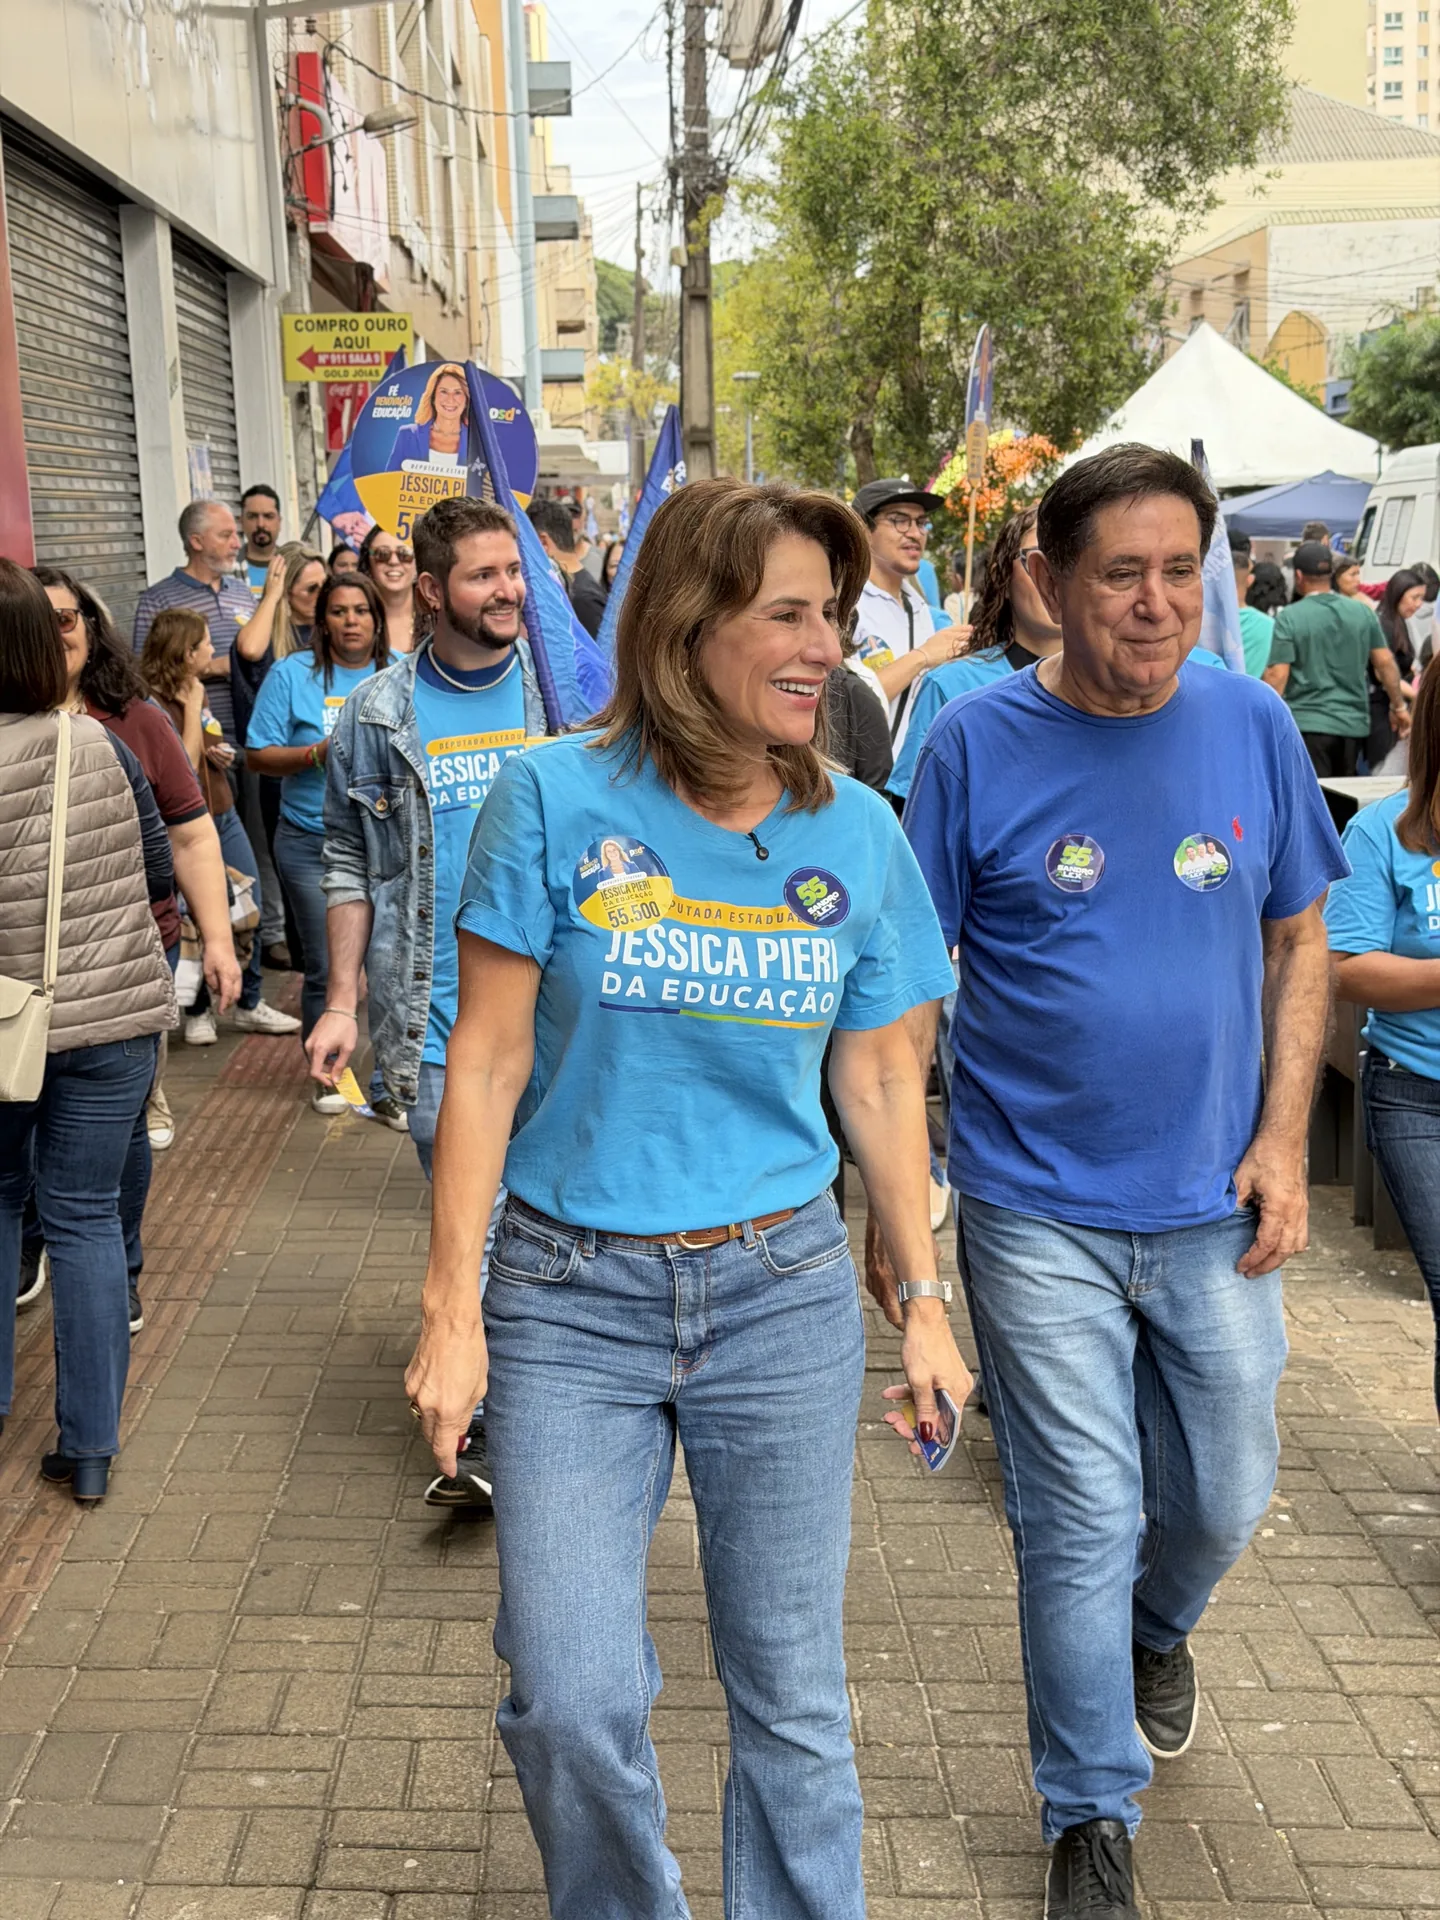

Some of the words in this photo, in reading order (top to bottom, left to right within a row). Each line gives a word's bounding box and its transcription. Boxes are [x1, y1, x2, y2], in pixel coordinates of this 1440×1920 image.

[294, 319, 359, 332] COMPRO
[364, 318, 408, 331] OURO
[333, 336, 371, 349] AQUI
[348, 353, 373, 364] SALA
[324, 369, 349, 378] GOLD
[388, 383, 400, 396] FÉ
[372, 406, 412, 420] EDUCAÇÃO
[399, 494, 414, 503] DA
[439, 738, 485, 750] DEPUTADA
[428, 752, 500, 789] ÉSSICA
[1060, 845, 1092, 867] 55
[1057, 864, 1094, 876] SANDRO
[631, 880, 652, 893] PIERI
[796, 875, 828, 906] 55
[616, 890, 653, 902] EDUCAÇÃO
[807, 891, 839, 915] SANDRO
[608, 901, 660, 928] 55.500
[669, 900, 722, 919] PUTADA
[756, 937, 839, 983] PIERI
[601, 971, 647, 998] DA
[661, 978, 835, 1017] EDUCAÇÃO
